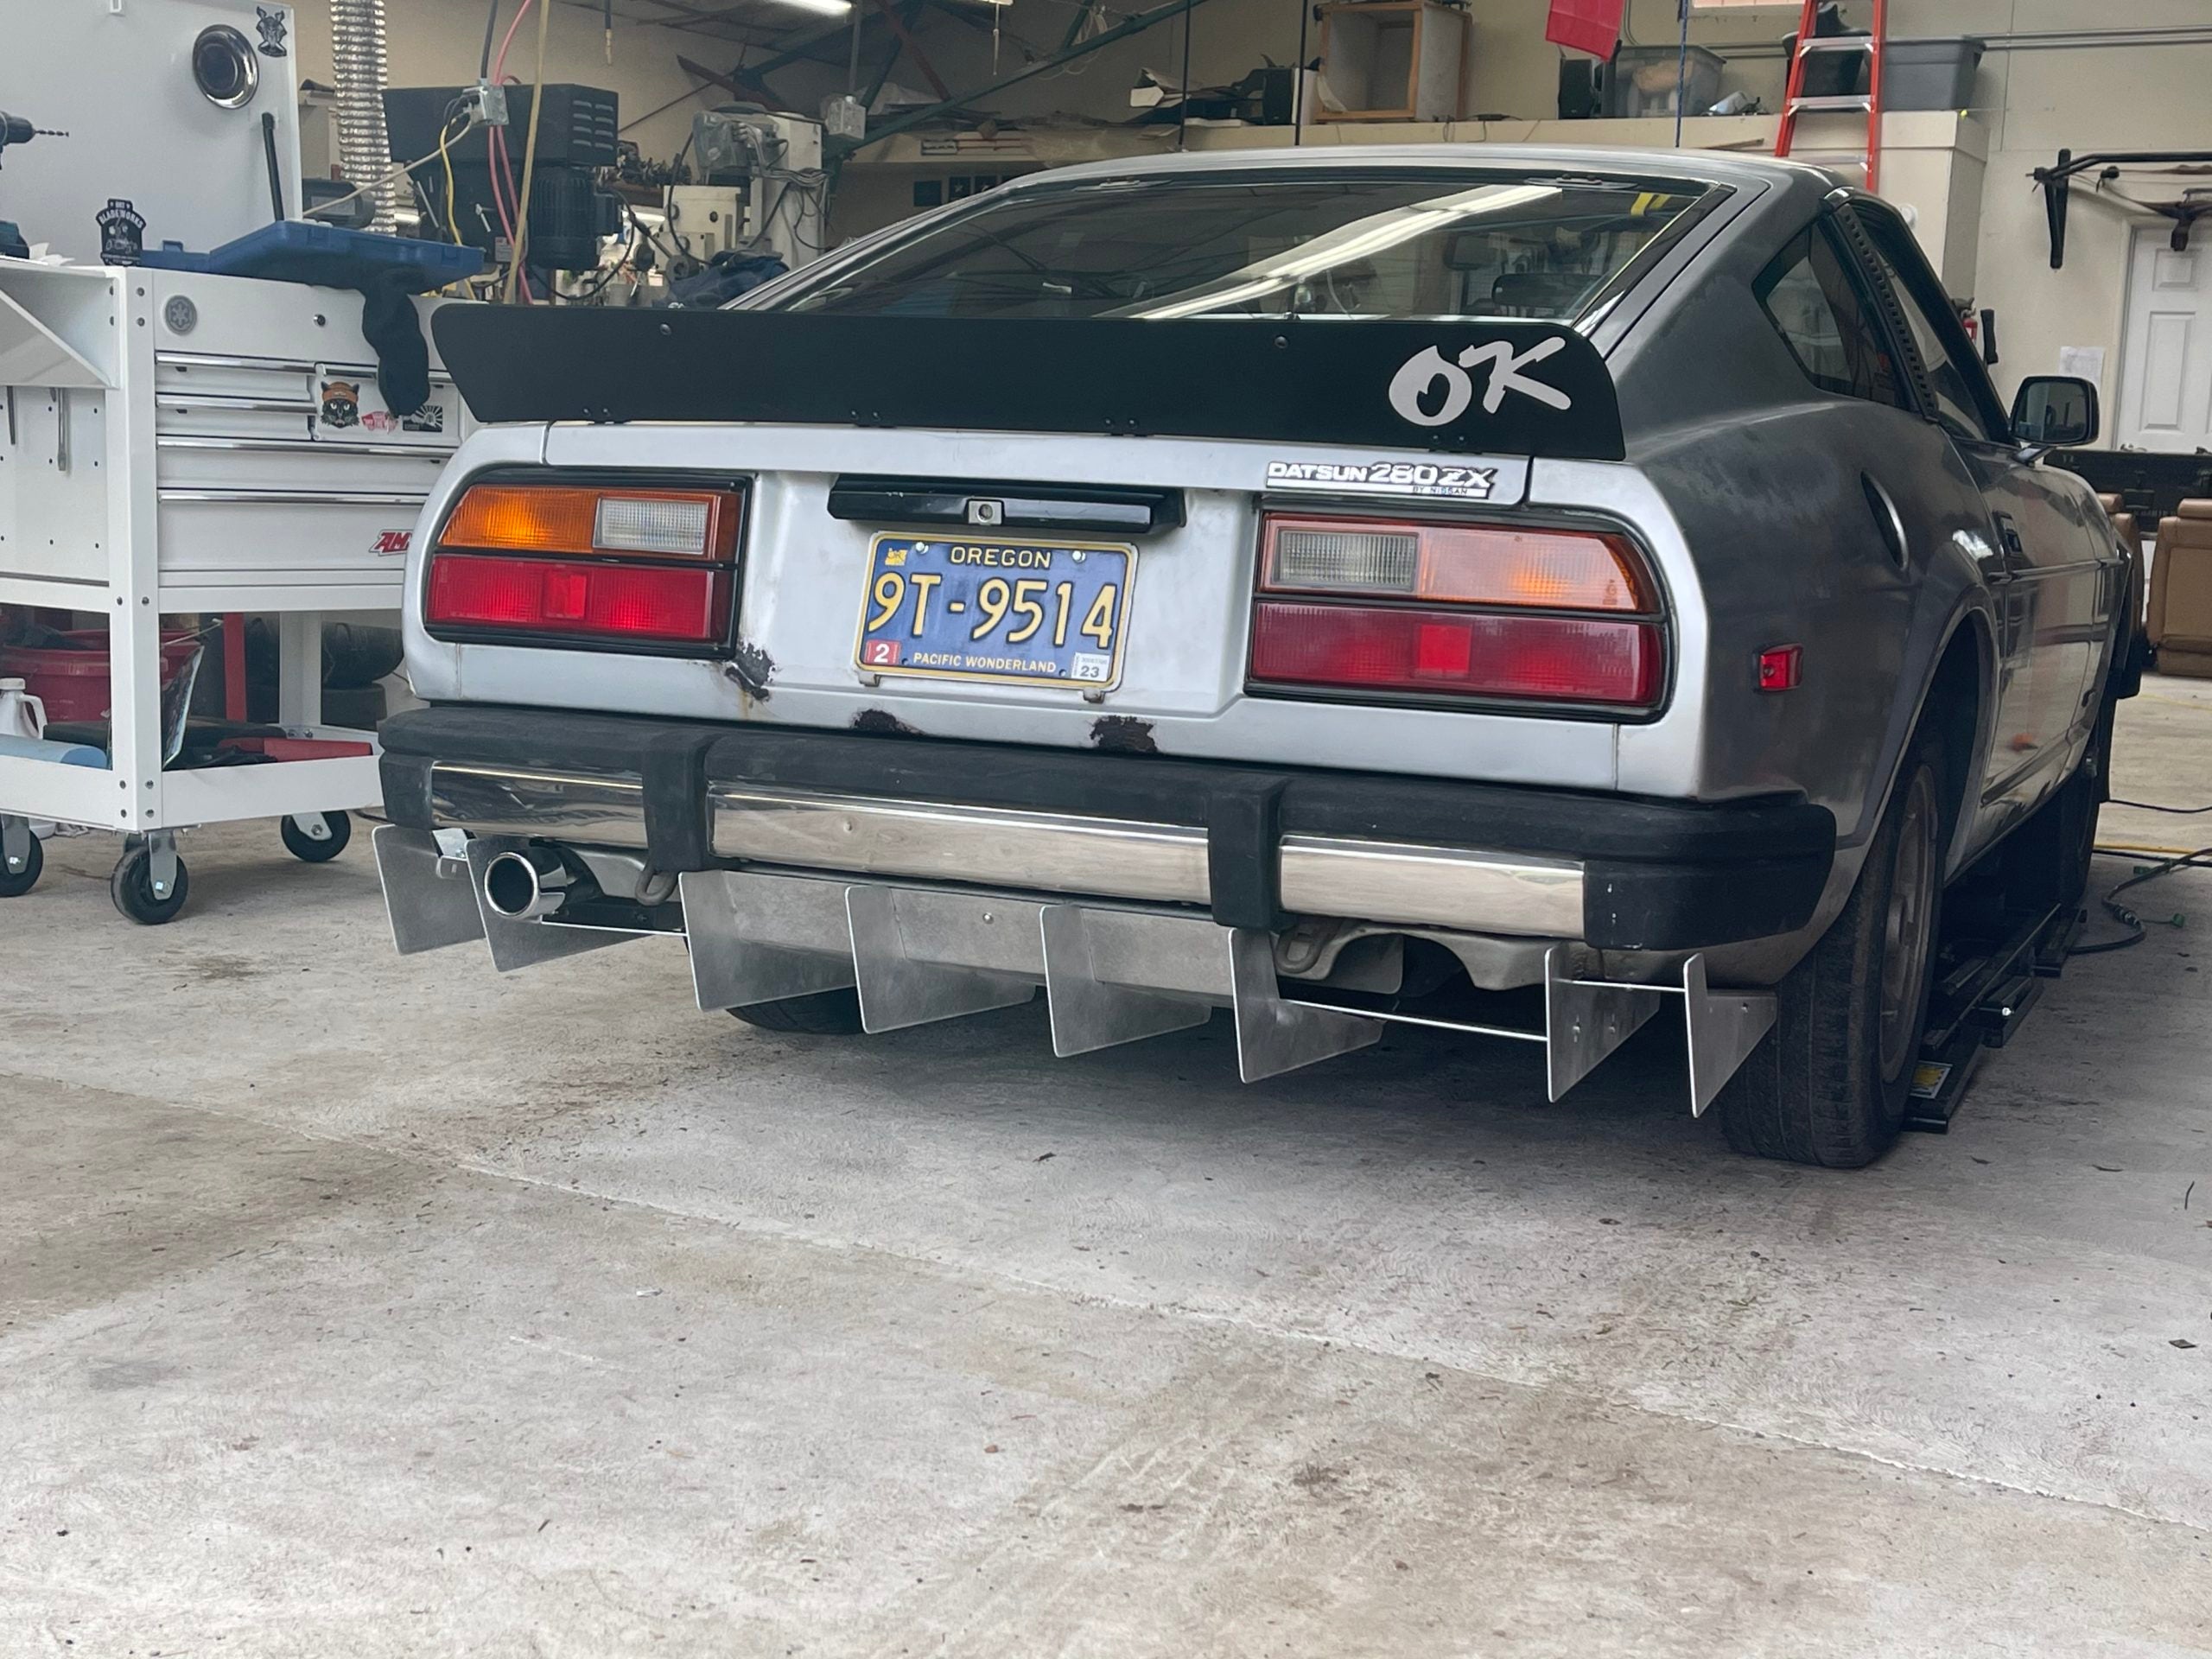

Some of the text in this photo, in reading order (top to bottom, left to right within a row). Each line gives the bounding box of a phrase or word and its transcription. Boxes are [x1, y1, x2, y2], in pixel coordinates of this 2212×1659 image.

[1389, 336, 1572, 427] OK
[1268, 461, 1368, 482] DATSUN
[1430, 486, 1468, 495] NISSAN
[950, 545, 1052, 569] OREGON
[867, 571, 1118, 650] 9T-9514
[874, 643, 890, 663] 2
[912, 652, 961, 667] PACIFIC
[965, 654, 1057, 674] WONDERLAND
[1079, 664, 1100, 678] 23
